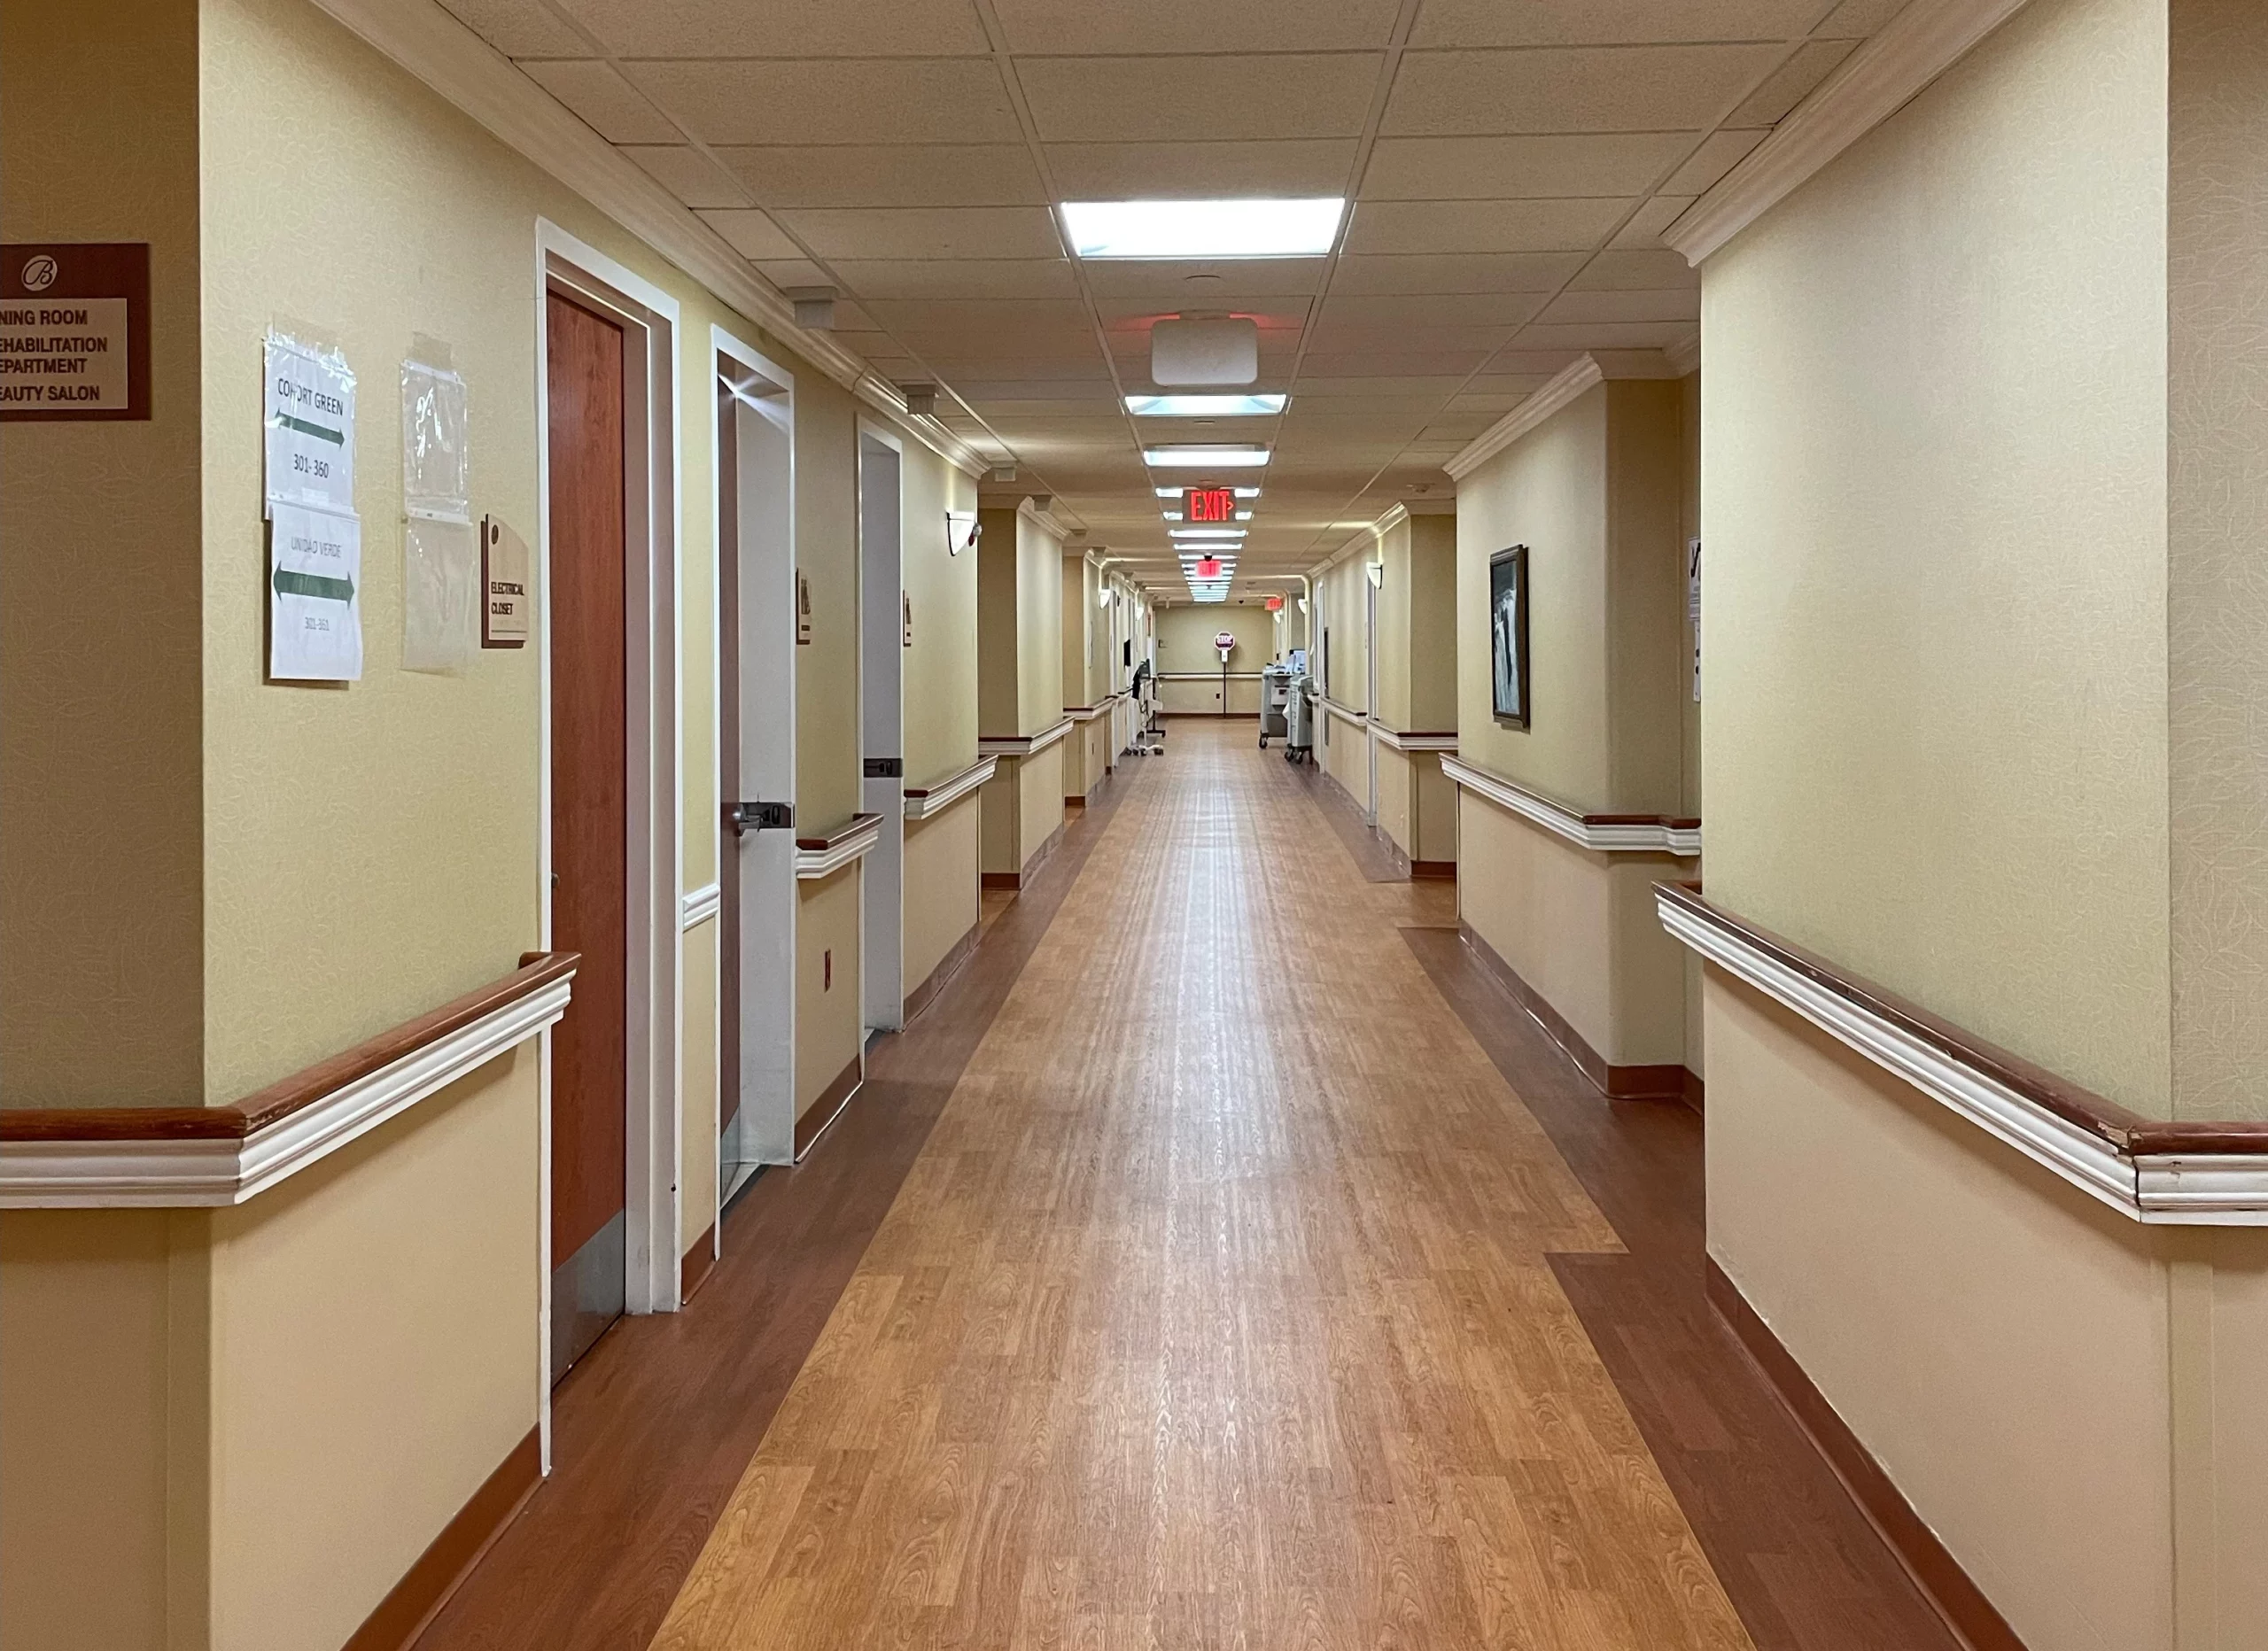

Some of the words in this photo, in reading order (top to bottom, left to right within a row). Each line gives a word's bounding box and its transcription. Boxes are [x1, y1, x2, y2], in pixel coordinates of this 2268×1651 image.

[40, 310, 88, 326] ROOM
[47, 385, 100, 401] SALON
[315, 392, 344, 416] GREEN
[1191, 491, 1230, 521] EXIT
[491, 601, 514, 616] CLOSET
